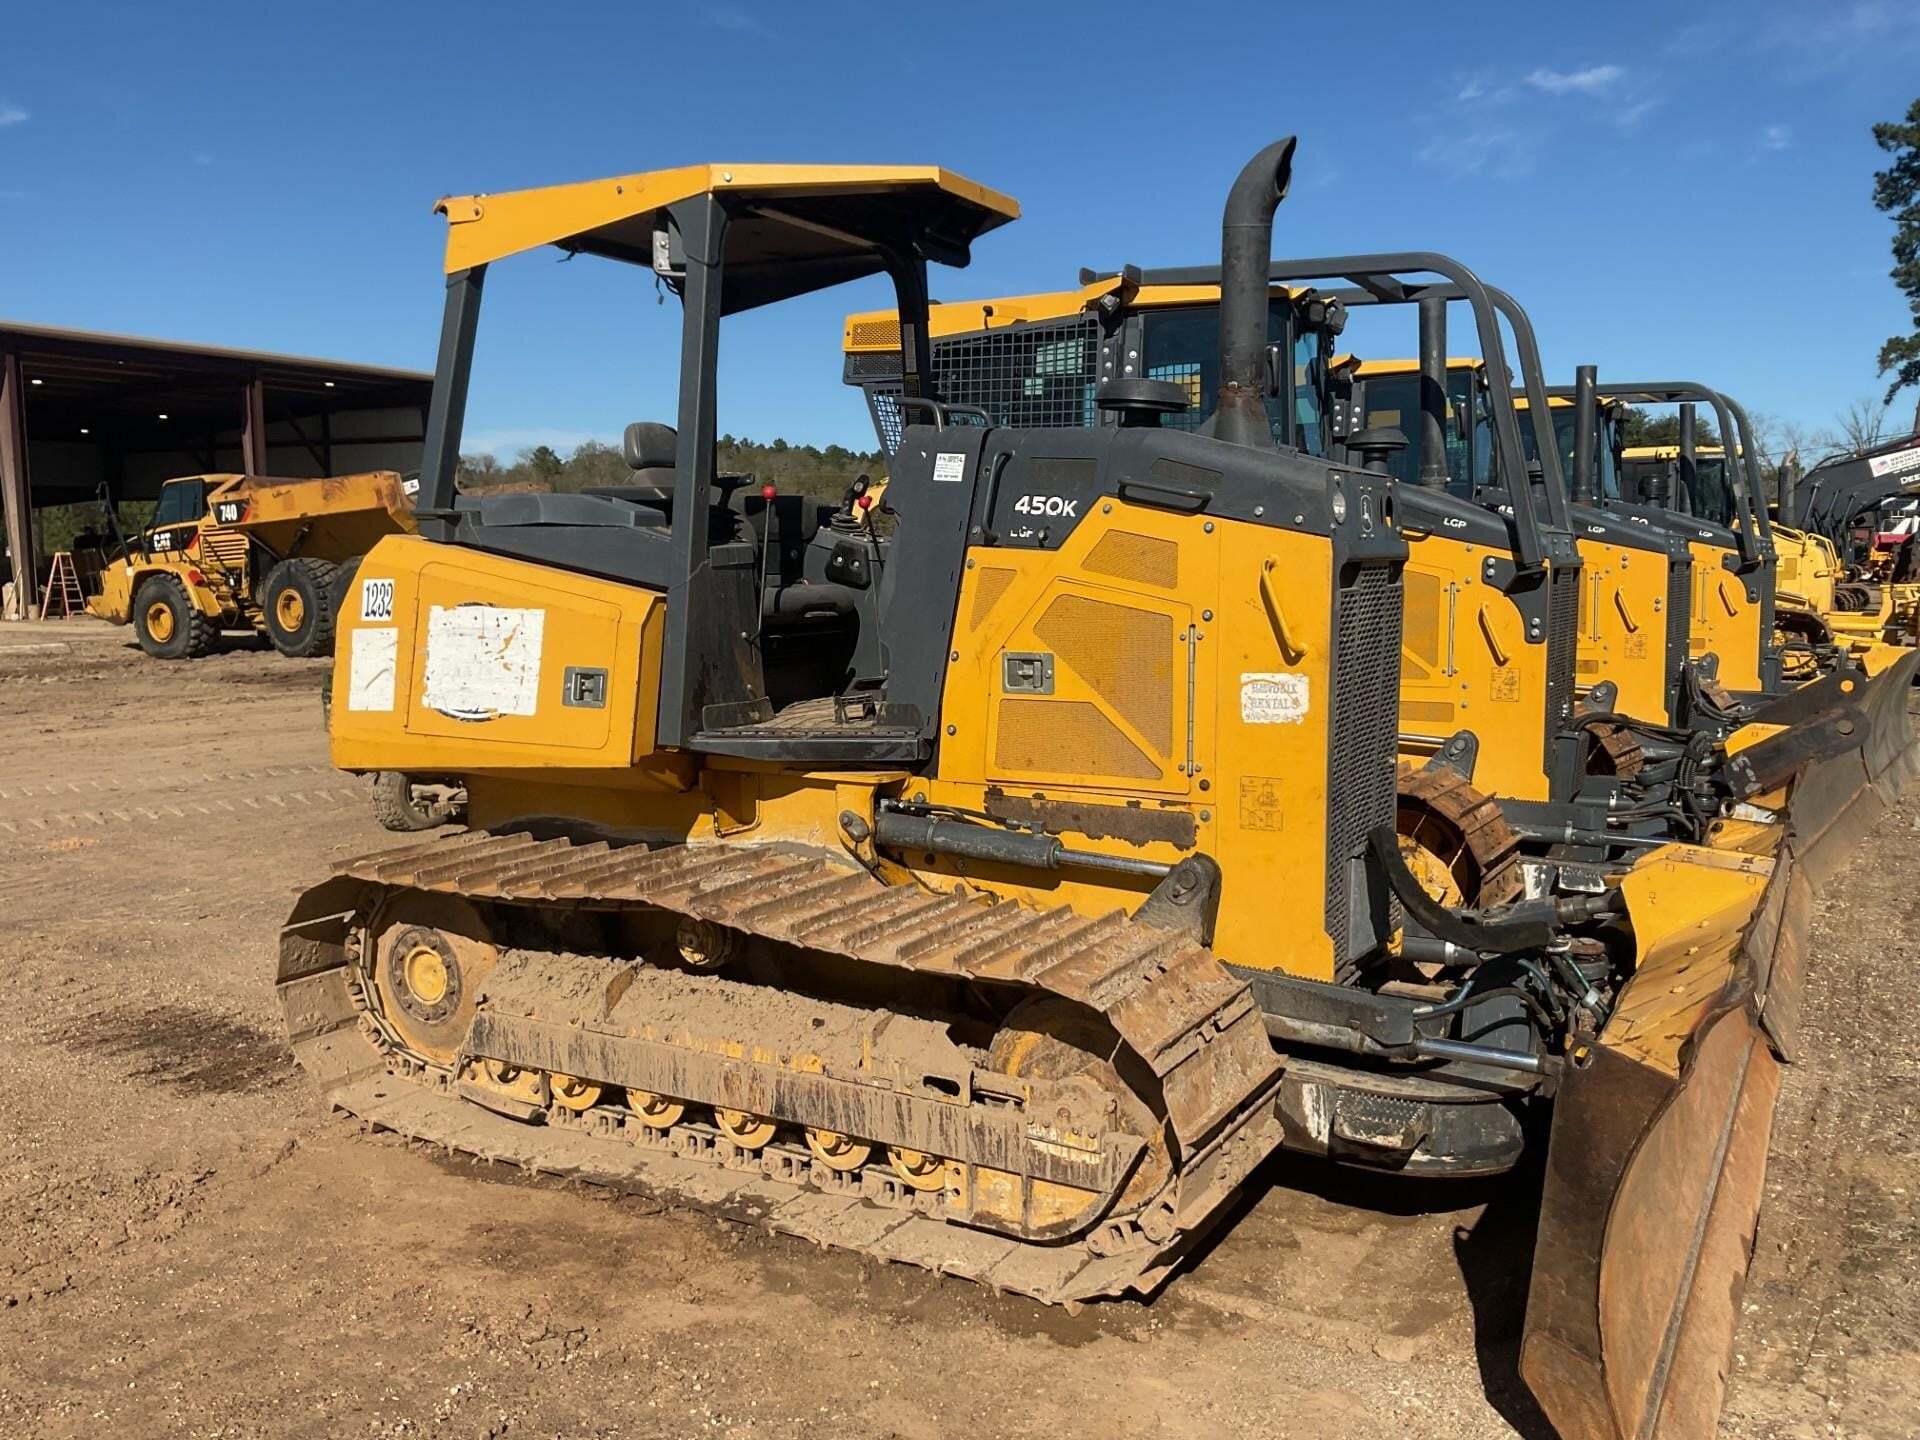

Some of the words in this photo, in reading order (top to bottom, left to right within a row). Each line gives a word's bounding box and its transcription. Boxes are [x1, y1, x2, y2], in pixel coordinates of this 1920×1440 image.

[220, 504, 237, 521] 740
[1014, 495, 1078, 517] 450K
[1443, 517, 1467, 528] LGP
[1588, 525, 1606, 534] LGP
[365, 583, 393, 617] 1232
